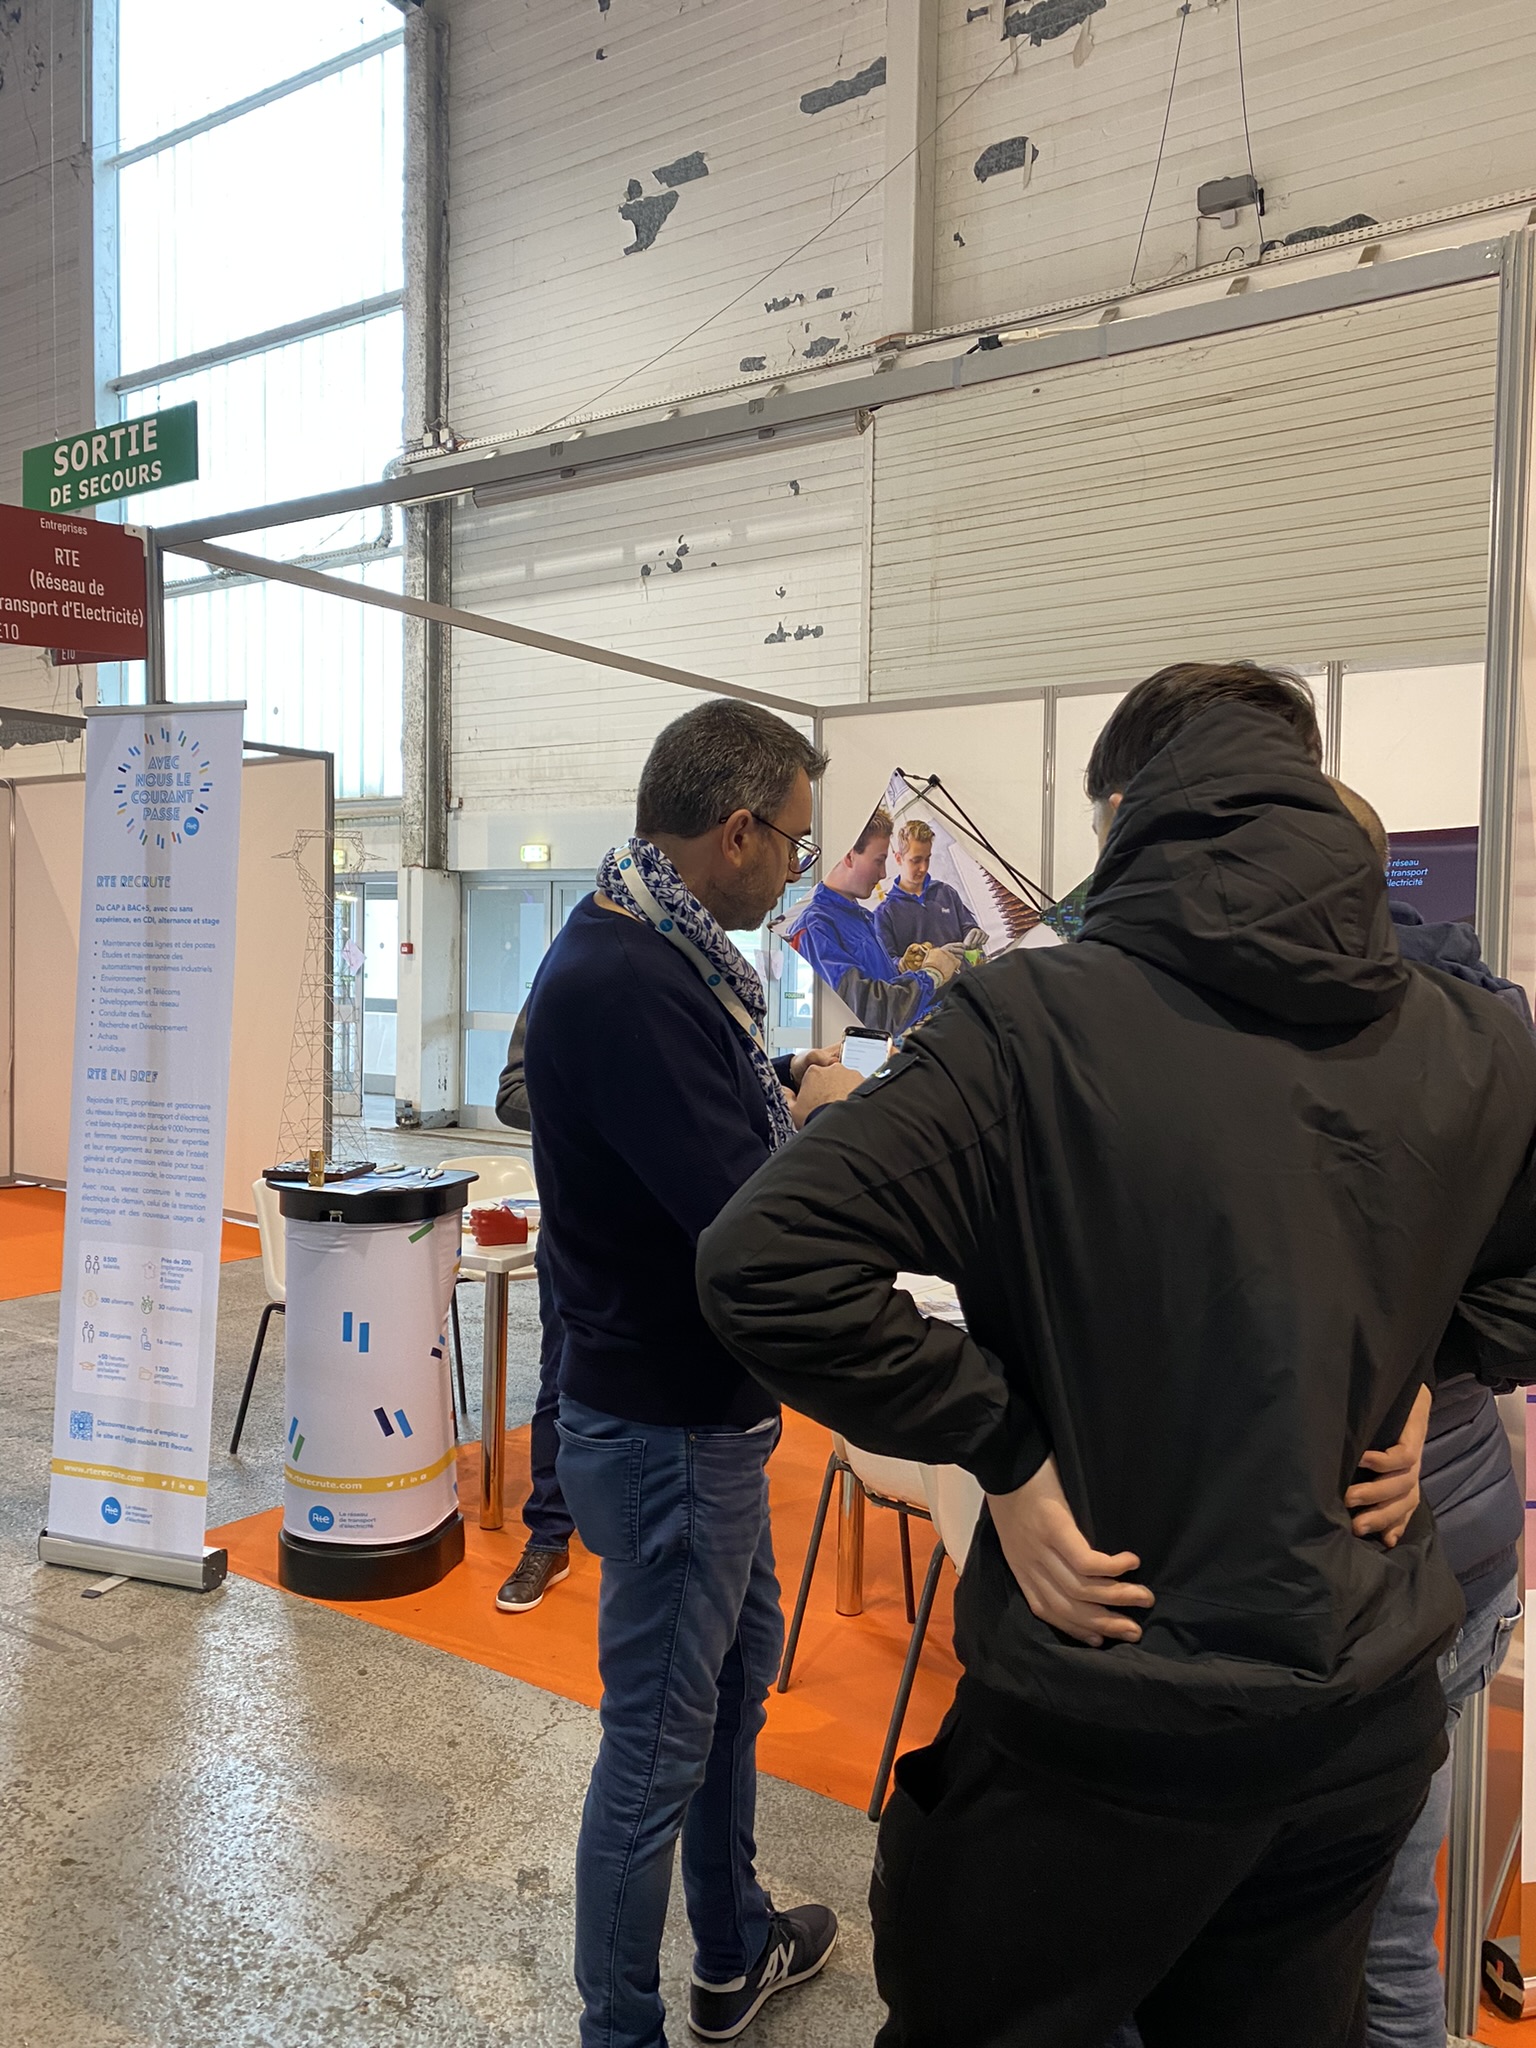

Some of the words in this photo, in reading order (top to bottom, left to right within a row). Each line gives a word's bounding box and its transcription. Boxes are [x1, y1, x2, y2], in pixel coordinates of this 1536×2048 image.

[53, 419, 157, 477] SORTIE
[50, 484, 71, 507] DE
[79, 461, 162, 500] SECOURS
[40, 518, 87, 536] Entreprises
[55, 548, 80, 567] RTE
[30, 569, 85, 593] (Réseau
[89, 579, 104, 596] de
[61, 601, 143, 628] d'Electricité)
[148, 755, 179, 770] AVEC
[135, 773, 173, 787] NOUS
[177, 773, 191, 786] LE
[131, 790, 194, 804] COURANT
[143, 807, 180, 821] PASSE
[1392, 859, 1419, 867] réseau
[1391, 868, 1428, 877] transport
[97, 876, 117, 887] RTE
[120, 876, 171, 888] RECRUTE
[95, 916, 131, 924] expérience,
[143, 916, 156, 924] CDI,
[202, 918, 219, 926] stage
[195, 942, 215, 950] postes
[87, 1068, 107, 1080] RTE
[111, 1069, 126, 1081] EN
[130, 1070, 158, 1083] BREF
[312, 1513, 330, 1524] Rte
